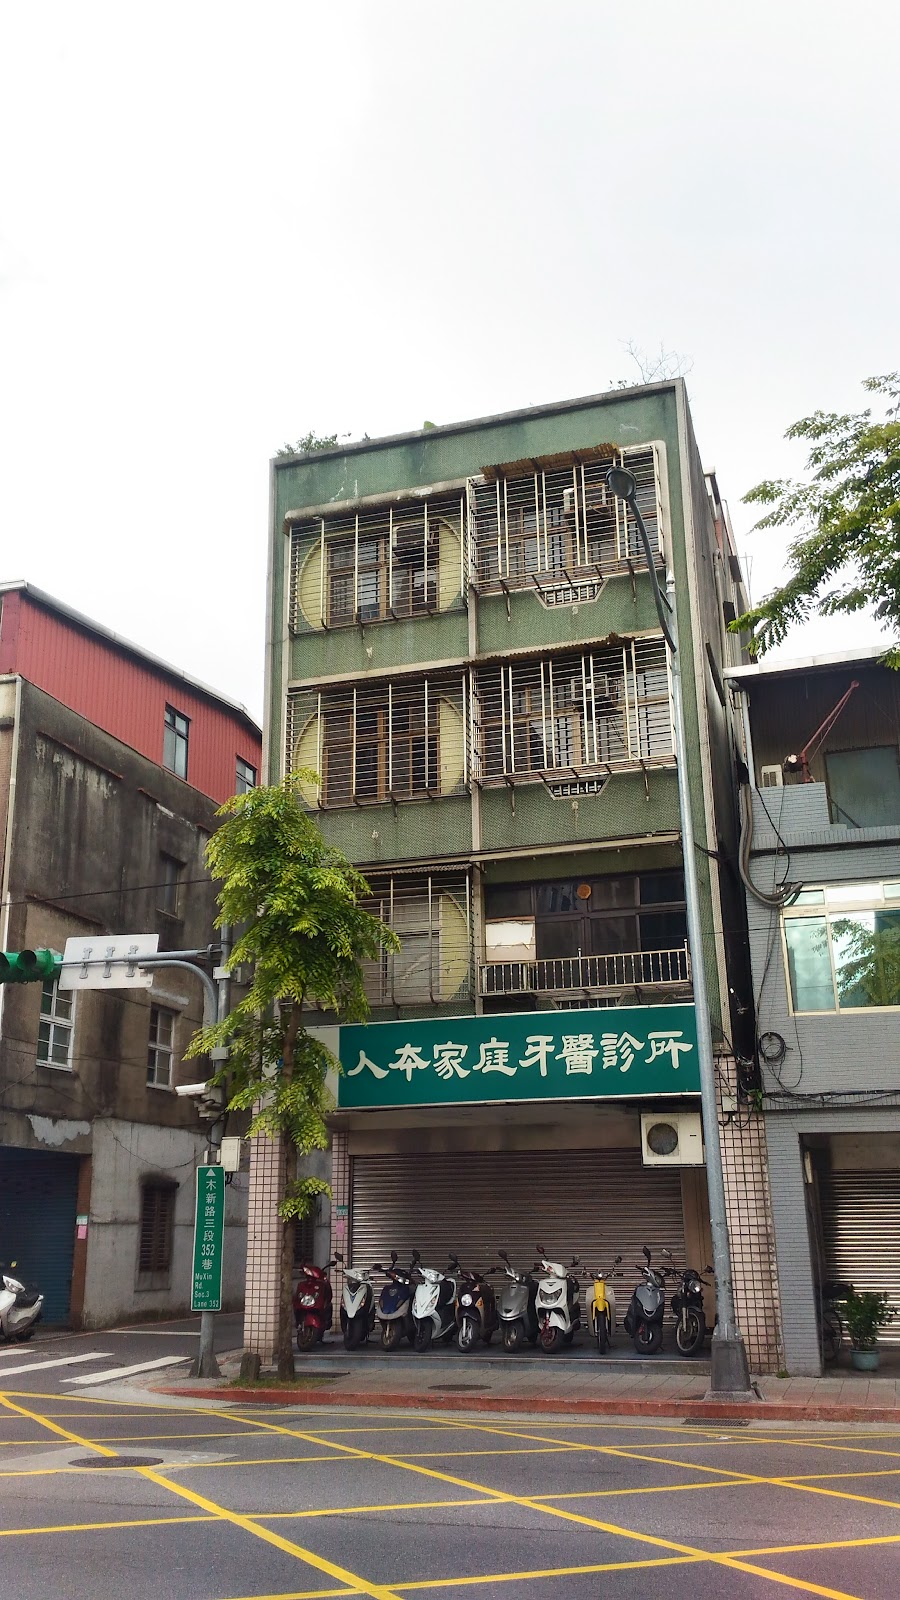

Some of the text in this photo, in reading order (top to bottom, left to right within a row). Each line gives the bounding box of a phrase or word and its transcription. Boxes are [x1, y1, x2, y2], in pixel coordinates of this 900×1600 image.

[347, 1031, 694, 1082] 人本家庭牙醫診所
[201, 1179, 217, 1270] 木新路三段352巷
[194, 1300, 219, 1308] Lane 352
